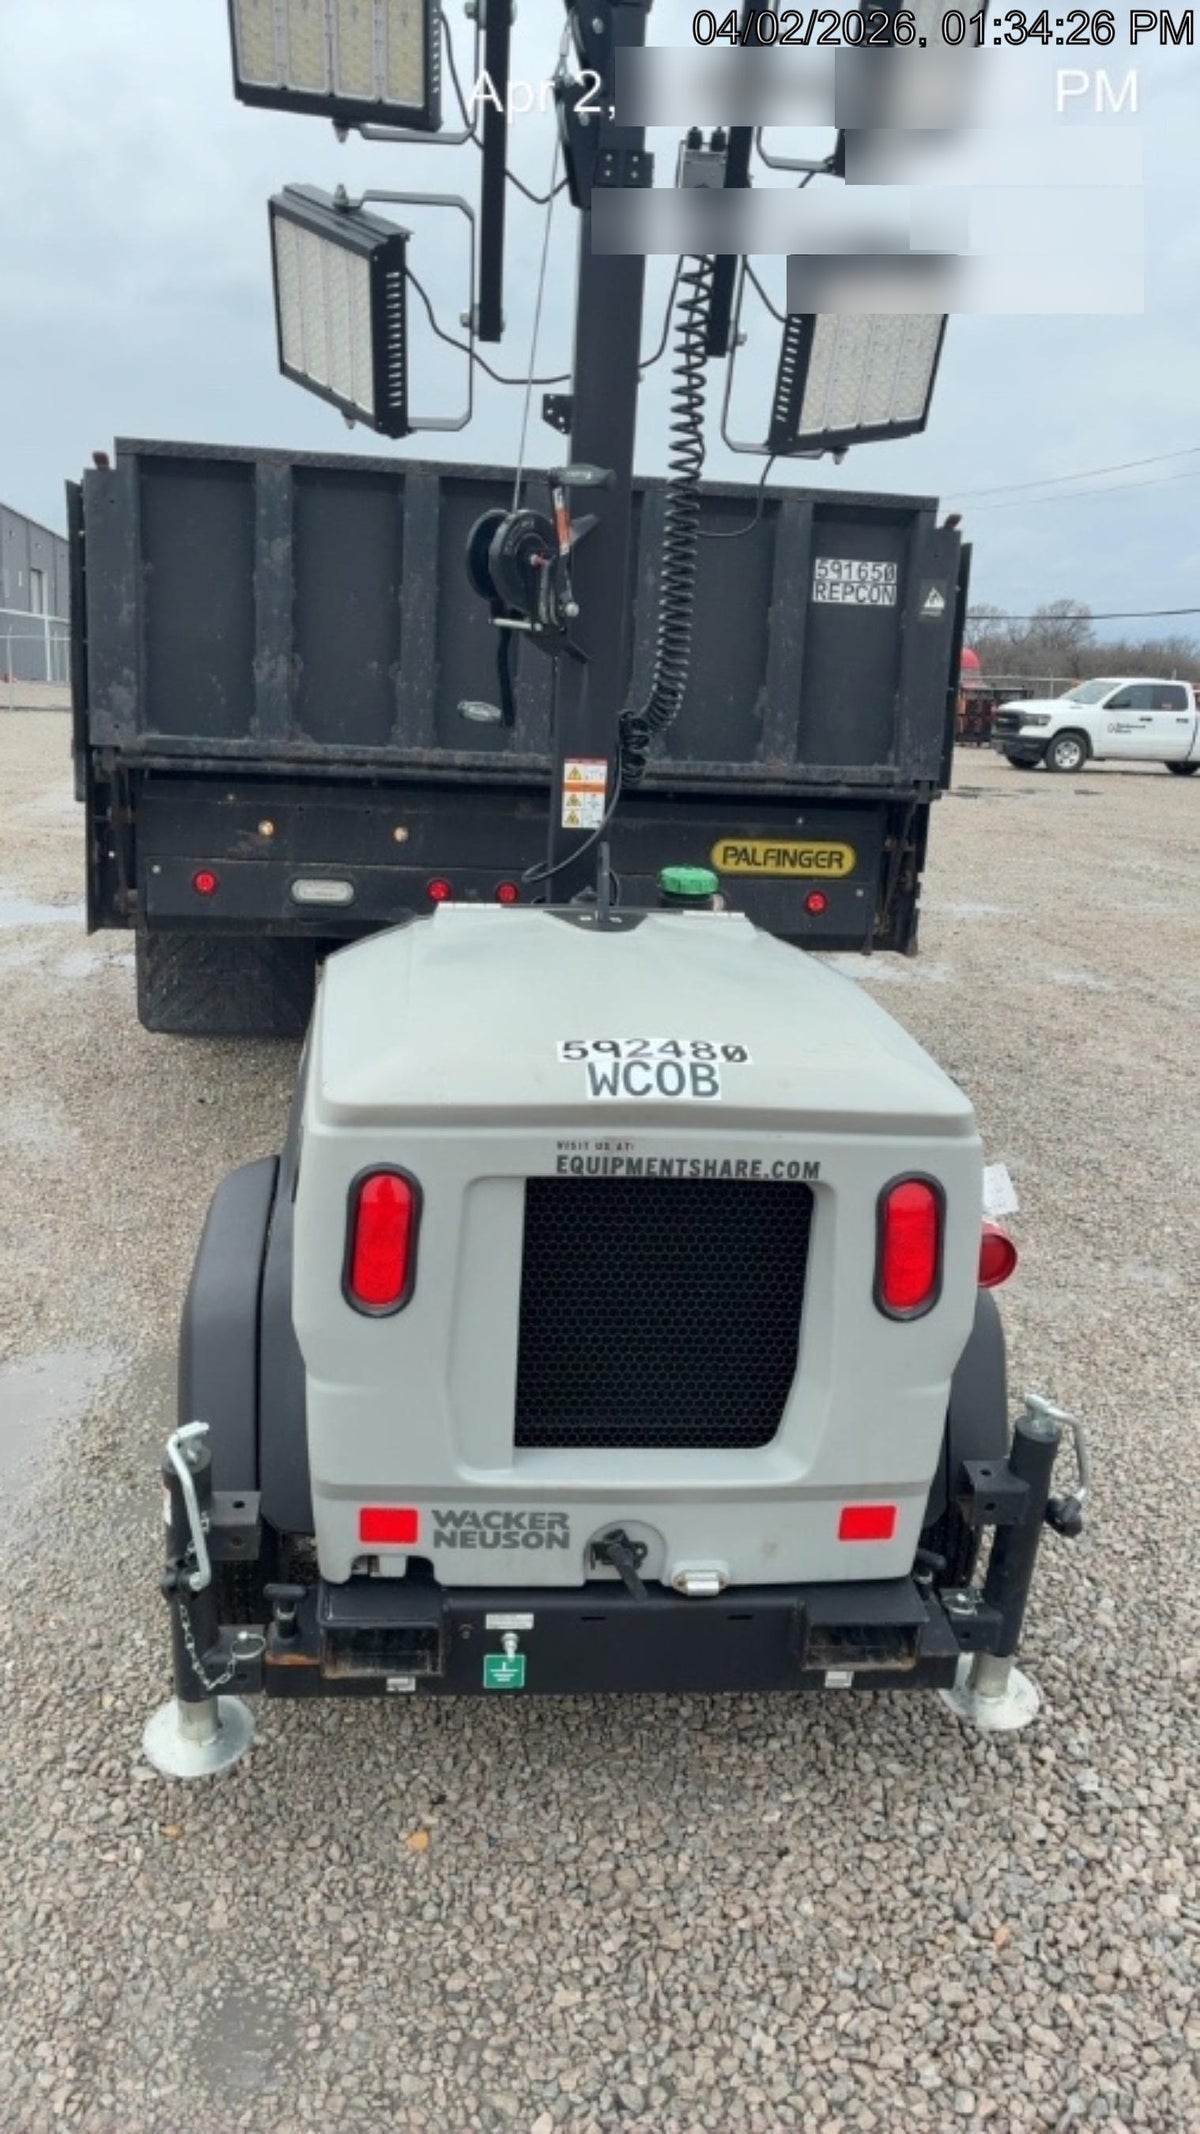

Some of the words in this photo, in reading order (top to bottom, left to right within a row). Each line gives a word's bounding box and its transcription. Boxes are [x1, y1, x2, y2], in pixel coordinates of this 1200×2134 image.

[816, 559, 895, 583] 591650
[814, 581, 896, 604] REPCON
[722, 846, 845, 869] PALFINGER
[563, 1039, 748, 1062] 592480
[588, 1060, 720, 1097] WCOB
[557, 1154, 820, 1178] EQUIPMENTSHARE.COM
[431, 1510, 570, 1530] WACKER
[433, 1530, 570, 1549] NEUSON
